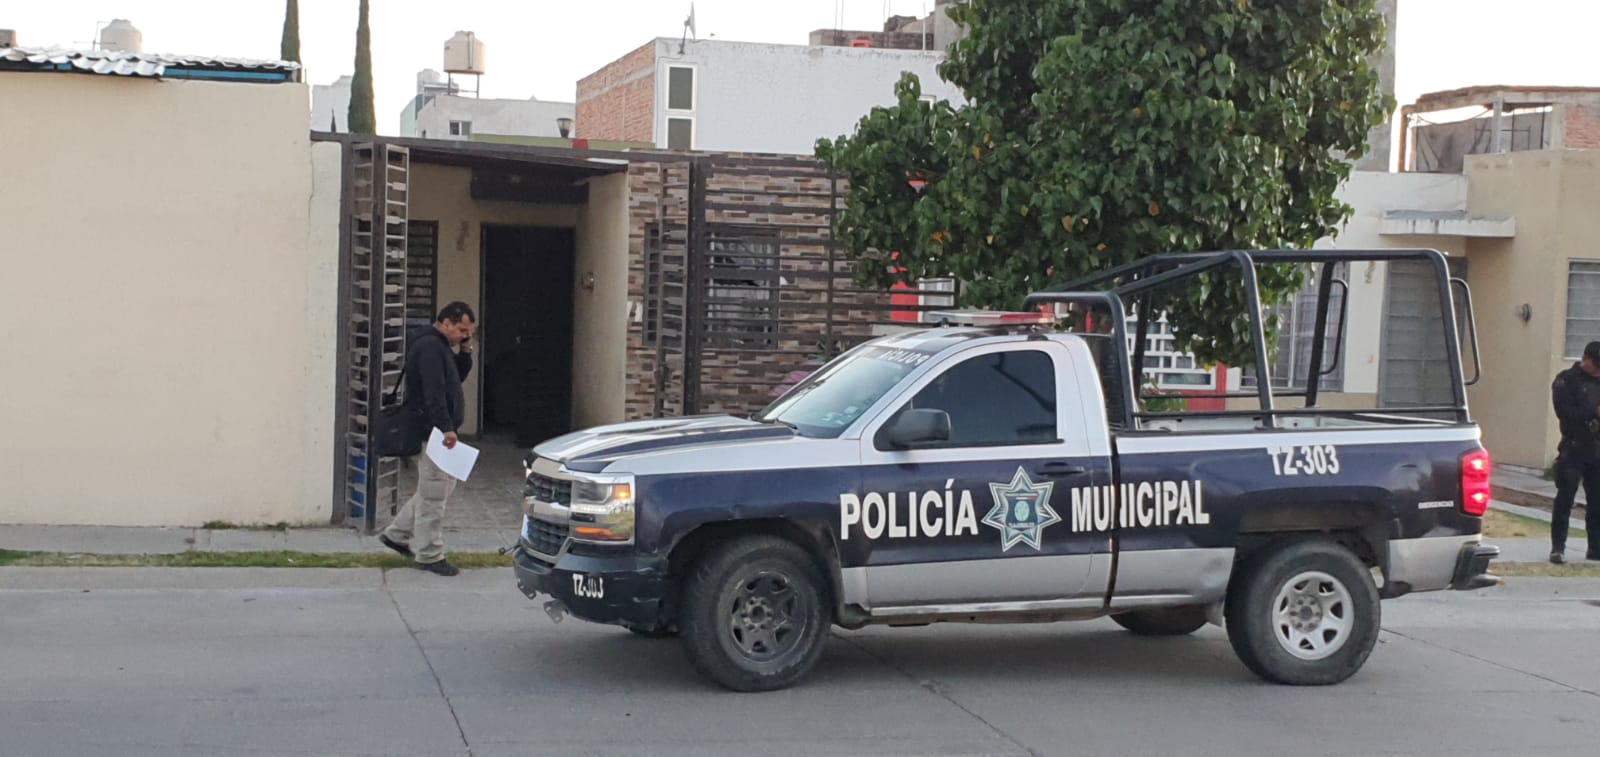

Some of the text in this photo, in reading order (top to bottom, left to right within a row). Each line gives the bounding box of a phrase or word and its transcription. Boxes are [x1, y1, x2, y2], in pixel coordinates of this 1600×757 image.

[1267, 445, 1340, 476] TZ-303
[839, 478, 1210, 540] POLICÍA MUNICIPAL
